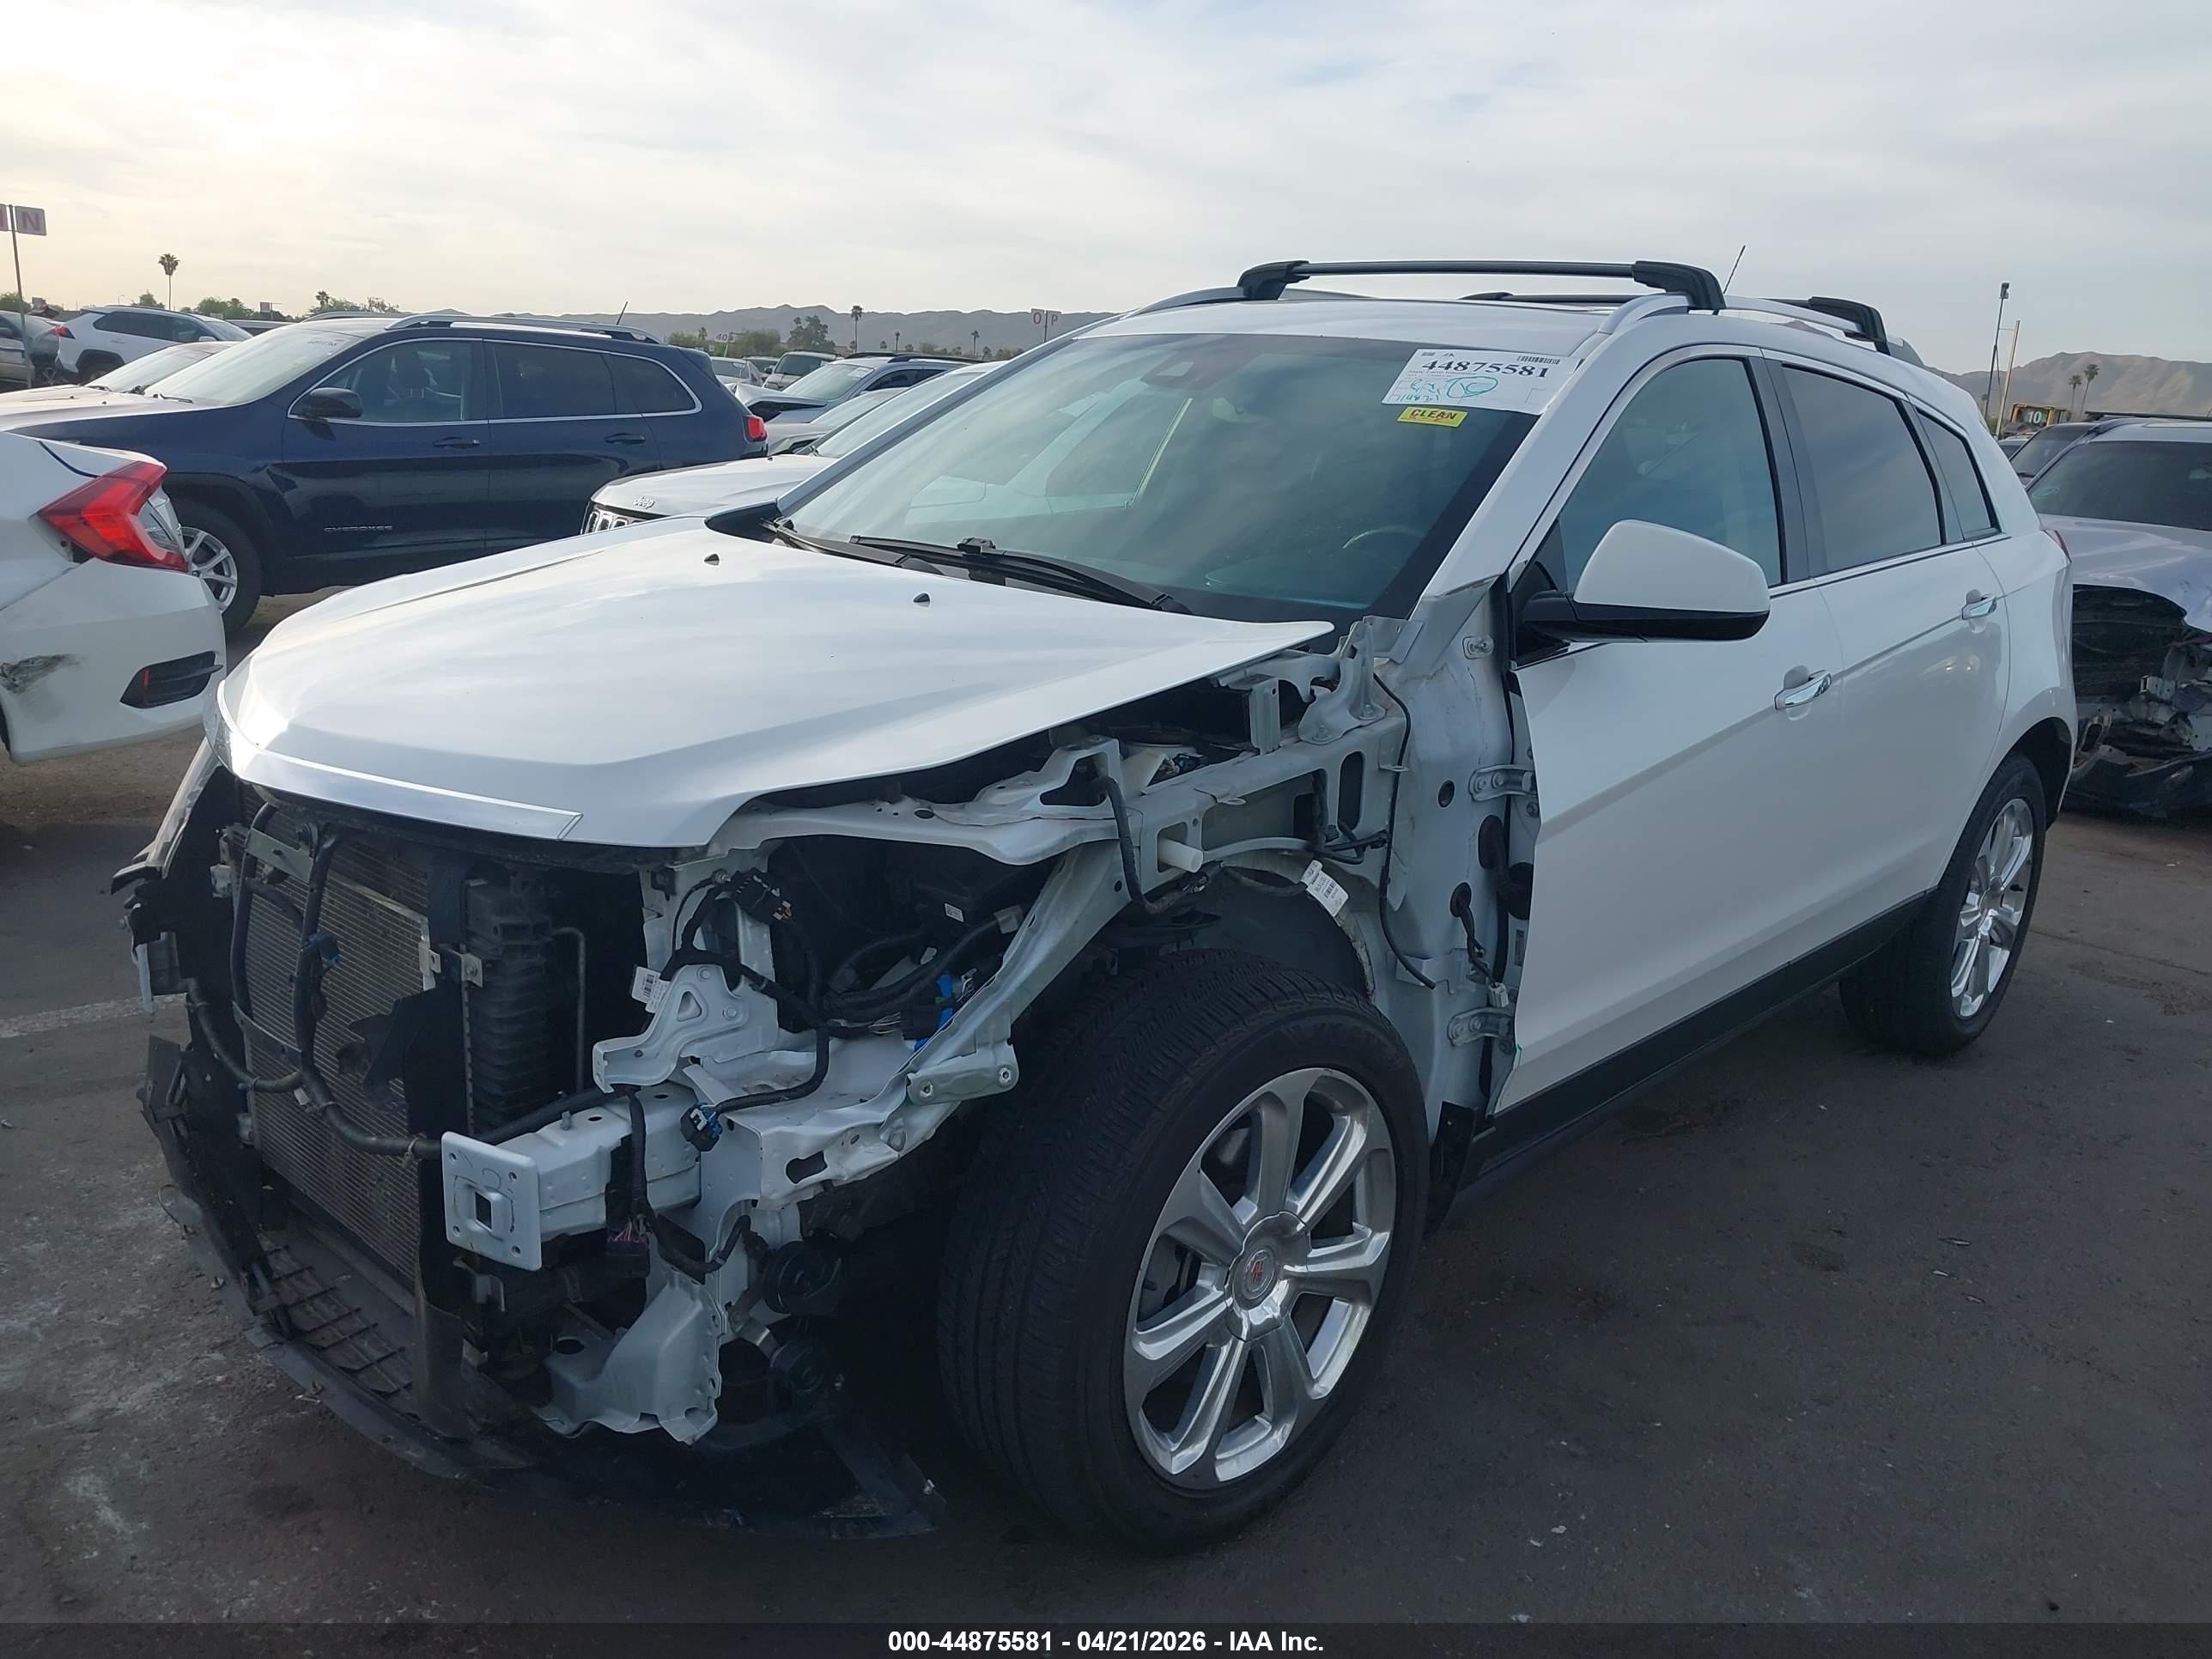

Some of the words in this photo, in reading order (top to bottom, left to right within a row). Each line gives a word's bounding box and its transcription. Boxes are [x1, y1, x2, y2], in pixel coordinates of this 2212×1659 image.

[22, 211, 40, 231] N
[1033, 312, 1042, 325] O
[1051, 314, 1058, 325] P
[1422, 360, 1549, 379] 44875581
[1410, 409, 1457, 420] CLEAN
[2028, 410, 2042, 424] 10
[633, 495, 655, 509] Jeep
